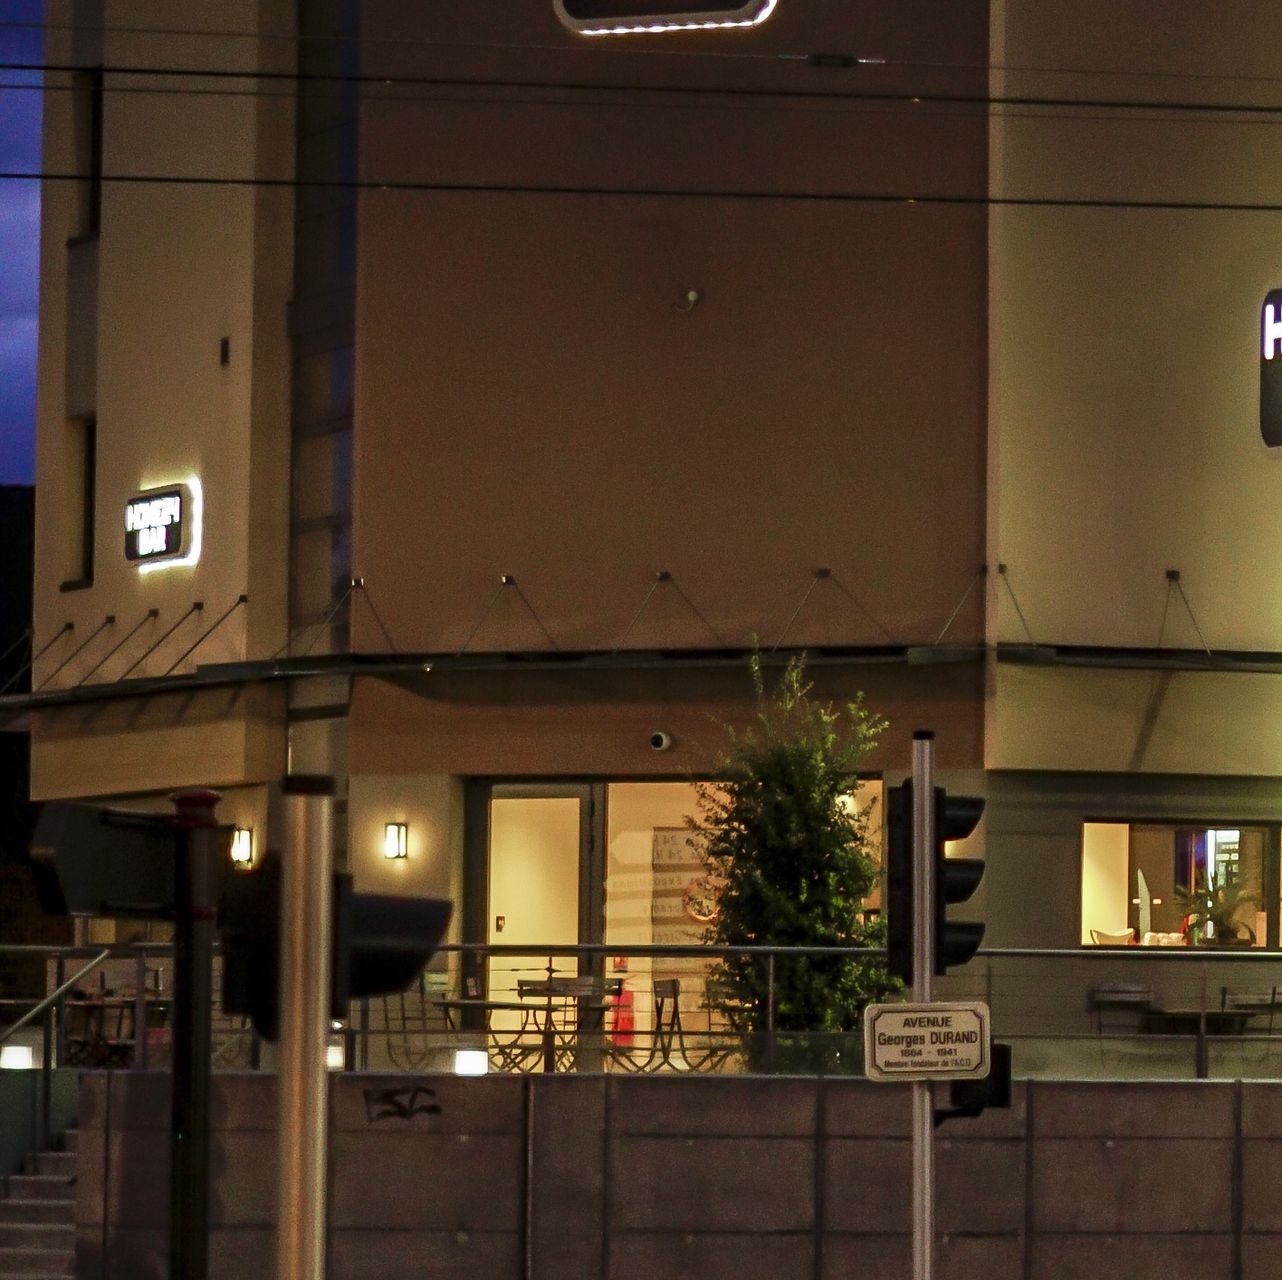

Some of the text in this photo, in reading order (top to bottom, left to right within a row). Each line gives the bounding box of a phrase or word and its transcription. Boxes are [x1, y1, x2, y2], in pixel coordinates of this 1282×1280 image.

[902, 1016, 953, 1028] AVENUE
[877, 1030, 978, 1048] Georges DURAND
